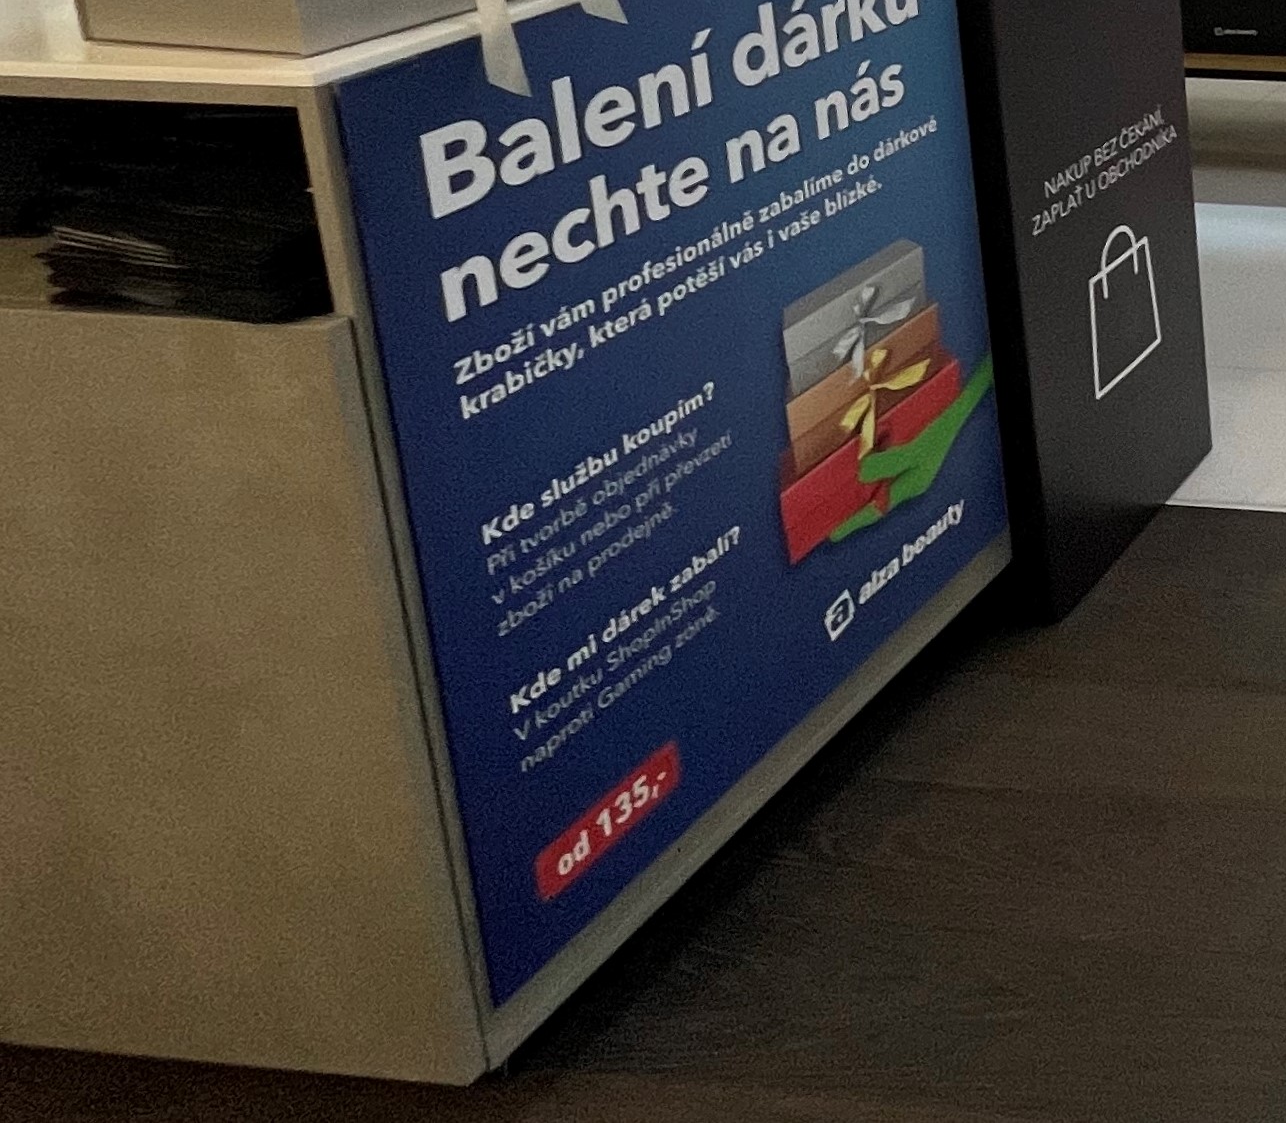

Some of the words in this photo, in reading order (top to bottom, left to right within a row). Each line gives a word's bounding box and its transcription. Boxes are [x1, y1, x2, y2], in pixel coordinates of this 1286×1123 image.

[420, 28, 713, 219] Balení
[1032, 184, 1083, 236] ZAPLAŤ
[1085, 179, 1096, 198] U
[1097, 124, 1178, 190] OBCHODNÍKA
[1044, 155, 1092, 198] NAKUP
[1094, 136, 1118, 167] BEZ
[440, 156, 709, 323] nechte
[727, 113, 800, 183] na
[814, 59, 906, 140] nás
[453, 323, 535, 385] Zboží
[540, 299, 595, 337] vám
[601, 211, 754, 313] profesionálně
[759, 168, 843, 223] zabalíme
[847, 154, 870, 175] do
[874, 114, 937, 162] dárkové
[460, 342, 584, 419] krabičky,
[588, 298, 652, 348] která
[657, 255, 725, 316] potěší
[728, 239, 763, 269] vás
[767, 229, 774, 249] i
[778, 207, 821, 242] vaše
[824, 174, 883, 217] blízké.
[481, 502, 535, 545] Kde
[540, 448, 618, 507] službu
[622, 381, 714, 455] koupím?
[492, 589, 505, 604] v
[509, 541, 576, 594] košíku
[580, 504, 631, 546] nebo
[558, 569, 584, 593] na
[859, 557, 900, 605] alza
[902, 499, 965, 566] beauty
[510, 668, 561, 714] Kde
[567, 633, 598, 671] mi
[602, 586, 666, 643] dárek
[521, 703, 595, 772] naproti
[598, 644, 672, 708] Gaming
[535, 668, 603, 728] koutku
[558, 829, 591, 876] od
[596, 771, 667, 837] 135,-
